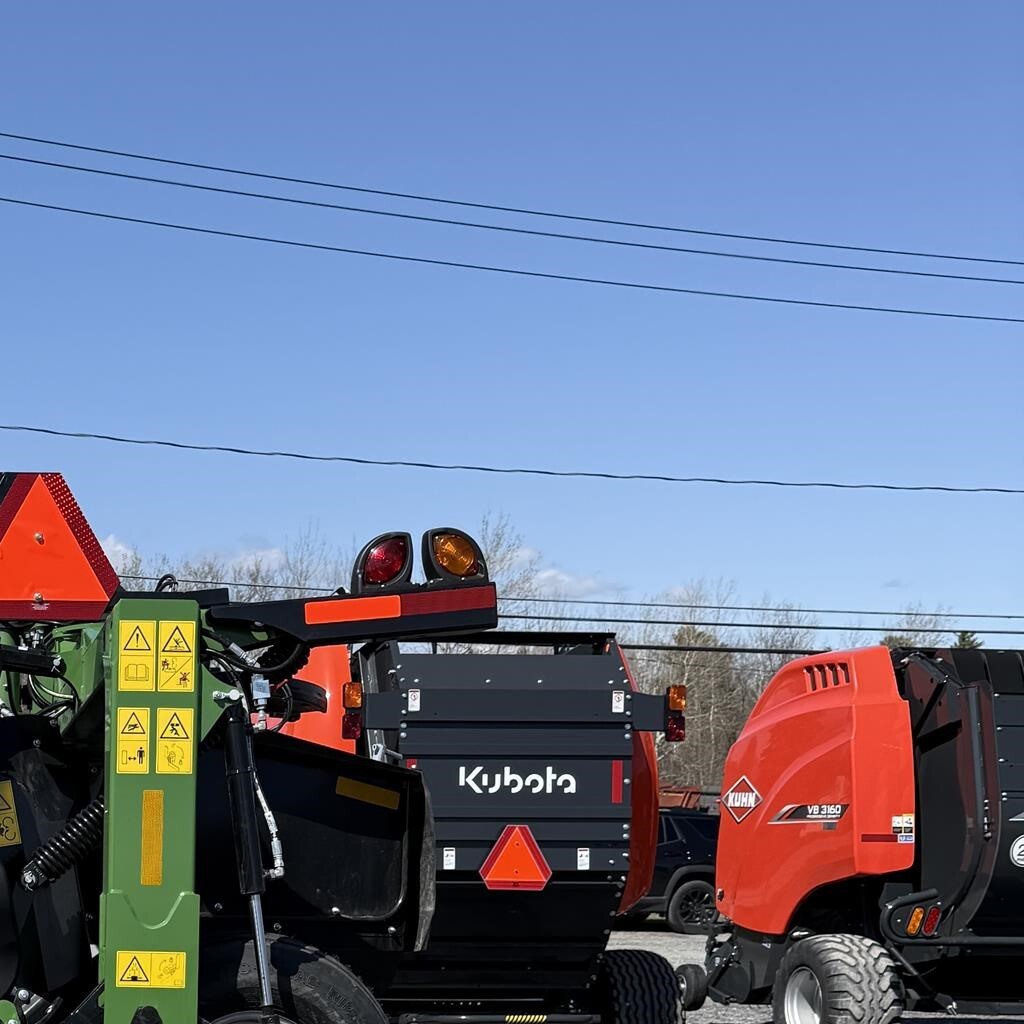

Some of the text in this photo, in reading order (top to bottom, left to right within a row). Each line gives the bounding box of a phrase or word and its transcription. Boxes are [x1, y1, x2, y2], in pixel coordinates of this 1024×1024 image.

[459, 766, 576, 793] Kubota
[727, 792, 756, 807] KUHN
[807, 805, 841, 814] VB 3160
